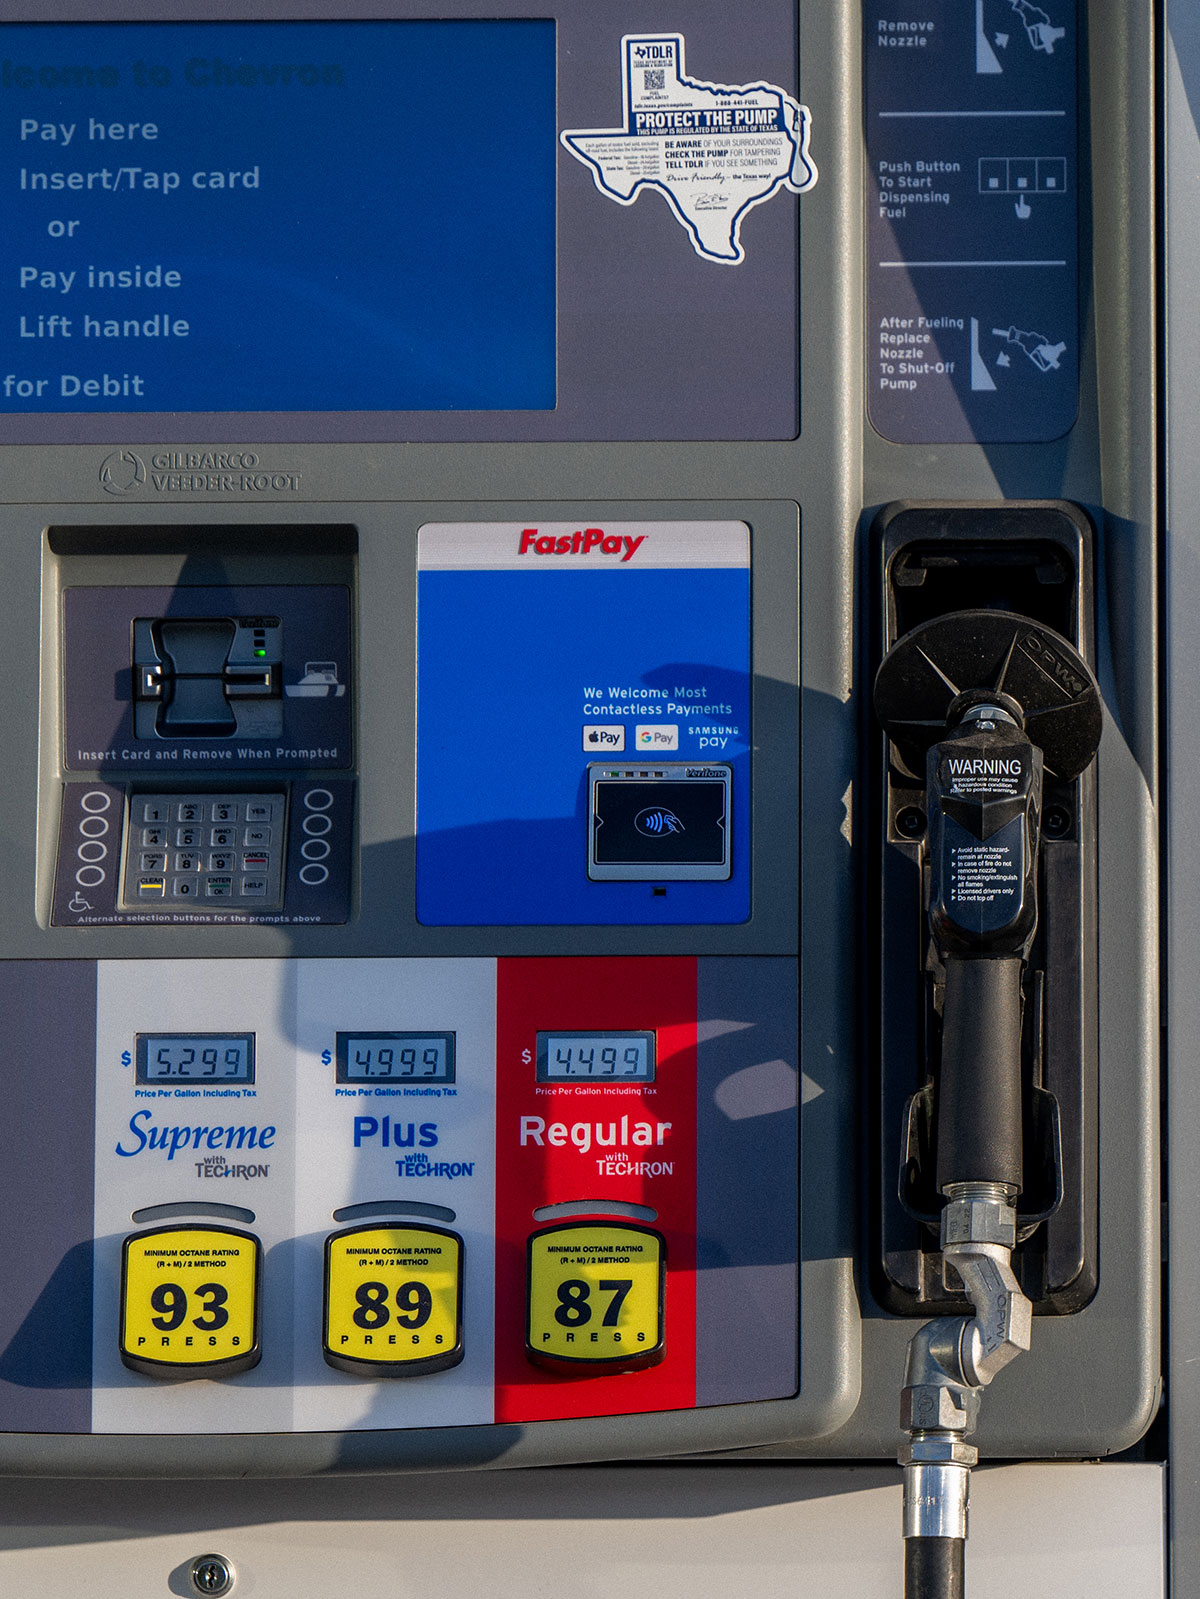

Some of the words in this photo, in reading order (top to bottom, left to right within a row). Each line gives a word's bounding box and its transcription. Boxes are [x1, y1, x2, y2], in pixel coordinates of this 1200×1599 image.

[877, 19, 935, 32] Remove
[877, 35, 927, 47] Nozzle
[644, 44, 673, 59] TDLR
[635, 111, 701, 128] PROTECT
[703, 110, 732, 126] THE
[734, 108, 778, 126] PUMP
[20, 118, 77, 147] Pay
[88, 117, 159, 141] here
[664, 141, 675, 149] BE
[676, 140, 702, 148] AWARE
[703, 139, 711, 147] OF
[713, 139, 731, 147] YOUR
[732, 138, 783, 147] SURROUNDINGS
[665, 150, 689, 159] CHECK
[691, 150, 705, 158] THE
[707, 149, 728, 157] PUMP
[744, 148, 781, 156] TAMPERING
[665, 161, 683, 169] TELL
[685, 160, 703, 168] TDLR
[705, 160, 710, 168] IF
[712, 159, 725, 167] YOU
[726, 159, 739, 167] SEE
[740, 158, 778, 167] SOMETHING
[879, 160, 912, 173] Push
[915, 160, 961, 173] Button
[20, 167, 181, 195] Insert/Tap
[191, 165, 260, 189] card
[878, 175, 895, 189] To
[897, 175, 932, 188] Start
[879, 190, 951, 205] Dispensing
[879, 206, 907, 219] Fuel
[47, 219, 81, 238] or
[20, 266, 77, 295] Pay
[88, 264, 182, 289] inside
[19, 314, 73, 338] Lift
[83, 313, 190, 338] handle
[879, 316, 915, 329] After
[917, 316, 965, 331] Fueling
[879, 332, 931, 347] Replace
[879, 347, 924, 359] Nozzle
[879, 362, 895, 375] To
[898, 361, 955, 375] Shut-Off
[2, 374, 49, 397] for
[60, 373, 145, 397] Debit
[879, 377, 918, 391] Pump
[151, 452, 258, 470] GILBARCO
[151, 473, 301, 492] VEEDER-ROOT
[517, 527, 646, 563] FastPay
[583, 687, 603, 699] We
[607, 686, 669, 699] Welcome
[674, 686, 707, 698] Most
[583, 703, 663, 716] Contactless
[667, 702, 733, 717] Payments
[687, 726, 739, 735] SAMSUNG
[600, 732, 620, 746] Pay
[654, 732, 673, 746] Pay
[699, 736, 728, 750] pay
[77, 749, 117, 761] Insert
[121, 749, 151, 761] Card
[155, 749, 178, 760] and
[182, 748, 233, 760] Remove
[237, 747, 271, 759] When
[275, 747, 338, 760] Prompted
[685, 767, 727, 778] Verifone
[948, 759, 1022, 776] WARNING
[152, 810, 159, 820] 1
[185, 810, 194, 820] 2
[219, 810, 229, 820] 3
[149, 835, 159, 844] 4
[184, 835, 193, 844] 5
[217, 834, 227, 844] 6
[242, 851, 269, 859] CANCEL
[148, 859, 157, 869] 7
[182, 859, 191, 869] 8
[216, 859, 225, 869] 9
[180, 884, 189, 894] 0
[77, 915, 124, 923] Alternate
[126, 913, 171, 922] selection
[172, 914, 211, 922] buttons
[213, 914, 228, 923] for
[229, 915, 247, 923] the
[248, 915, 291, 924] prompts
[292, 915, 321, 923] above
[121, 1050, 131, 1067] $
[157, 1049, 240, 1075] 5.299
[322, 1050, 331, 1066] $
[356, 1049, 438, 1076] 4.999
[522, 1048, 531, 1064] $
[556, 1048, 639, 1074] 4.499
[134, 1089, 157, 1098] Price
[157, 1089, 173, 1098] Per
[173, 1089, 202, 1098] Gallon
[202, 1089, 241, 1099] Including
[241, 1088, 257, 1097] Tax
[334, 1088, 357, 1097] Price
[357, 1088, 373, 1097] Per
[374, 1087, 402, 1097] Gallon
[403, 1087, 442, 1098] Including
[441, 1087, 458, 1097] Tax
[535, 1087, 558, 1096] Price
[557, 1087, 573, 1096] Per
[574, 1086, 602, 1096] Gallon
[603, 1087, 642, 1097] Including
[643, 1087, 657, 1095] Tax
[115, 1110, 277, 1160] Supreme
[353, 1115, 439, 1148] Plus
[520, 1114, 673, 1153] Regular
[203, 1155, 227, 1165] with
[403, 1152, 429, 1163] with
[605, 1151, 629, 1162] with
[194, 1161, 271, 1181] TECHRON
[395, 1159, 476, 1181] TECHRON
[595, 1158, 673, 1179] TECHRON
[143, 1249, 178, 1257] MINIMUM
[178, 1249, 211, 1257] OCTANE
[211, 1249, 240, 1257] RATING
[345, 1247, 381, 1255] MINIMUM
[380, 1247, 413, 1255] OCTANE
[413, 1247, 443, 1255] RATING
[547, 1245, 582, 1253] MINIMUM
[582, 1245, 614, 1253] OCTANE
[615, 1245, 644, 1253] RATING
[151, 1283, 228, 1331] 93
[353, 1281, 432, 1330] 89
[554, 1280, 632, 1327] 87
[137, 1335, 241, 1347] PRESS
[340, 1333, 444, 1345] PRESS
[542, 1331, 646, 1343] PRESS
